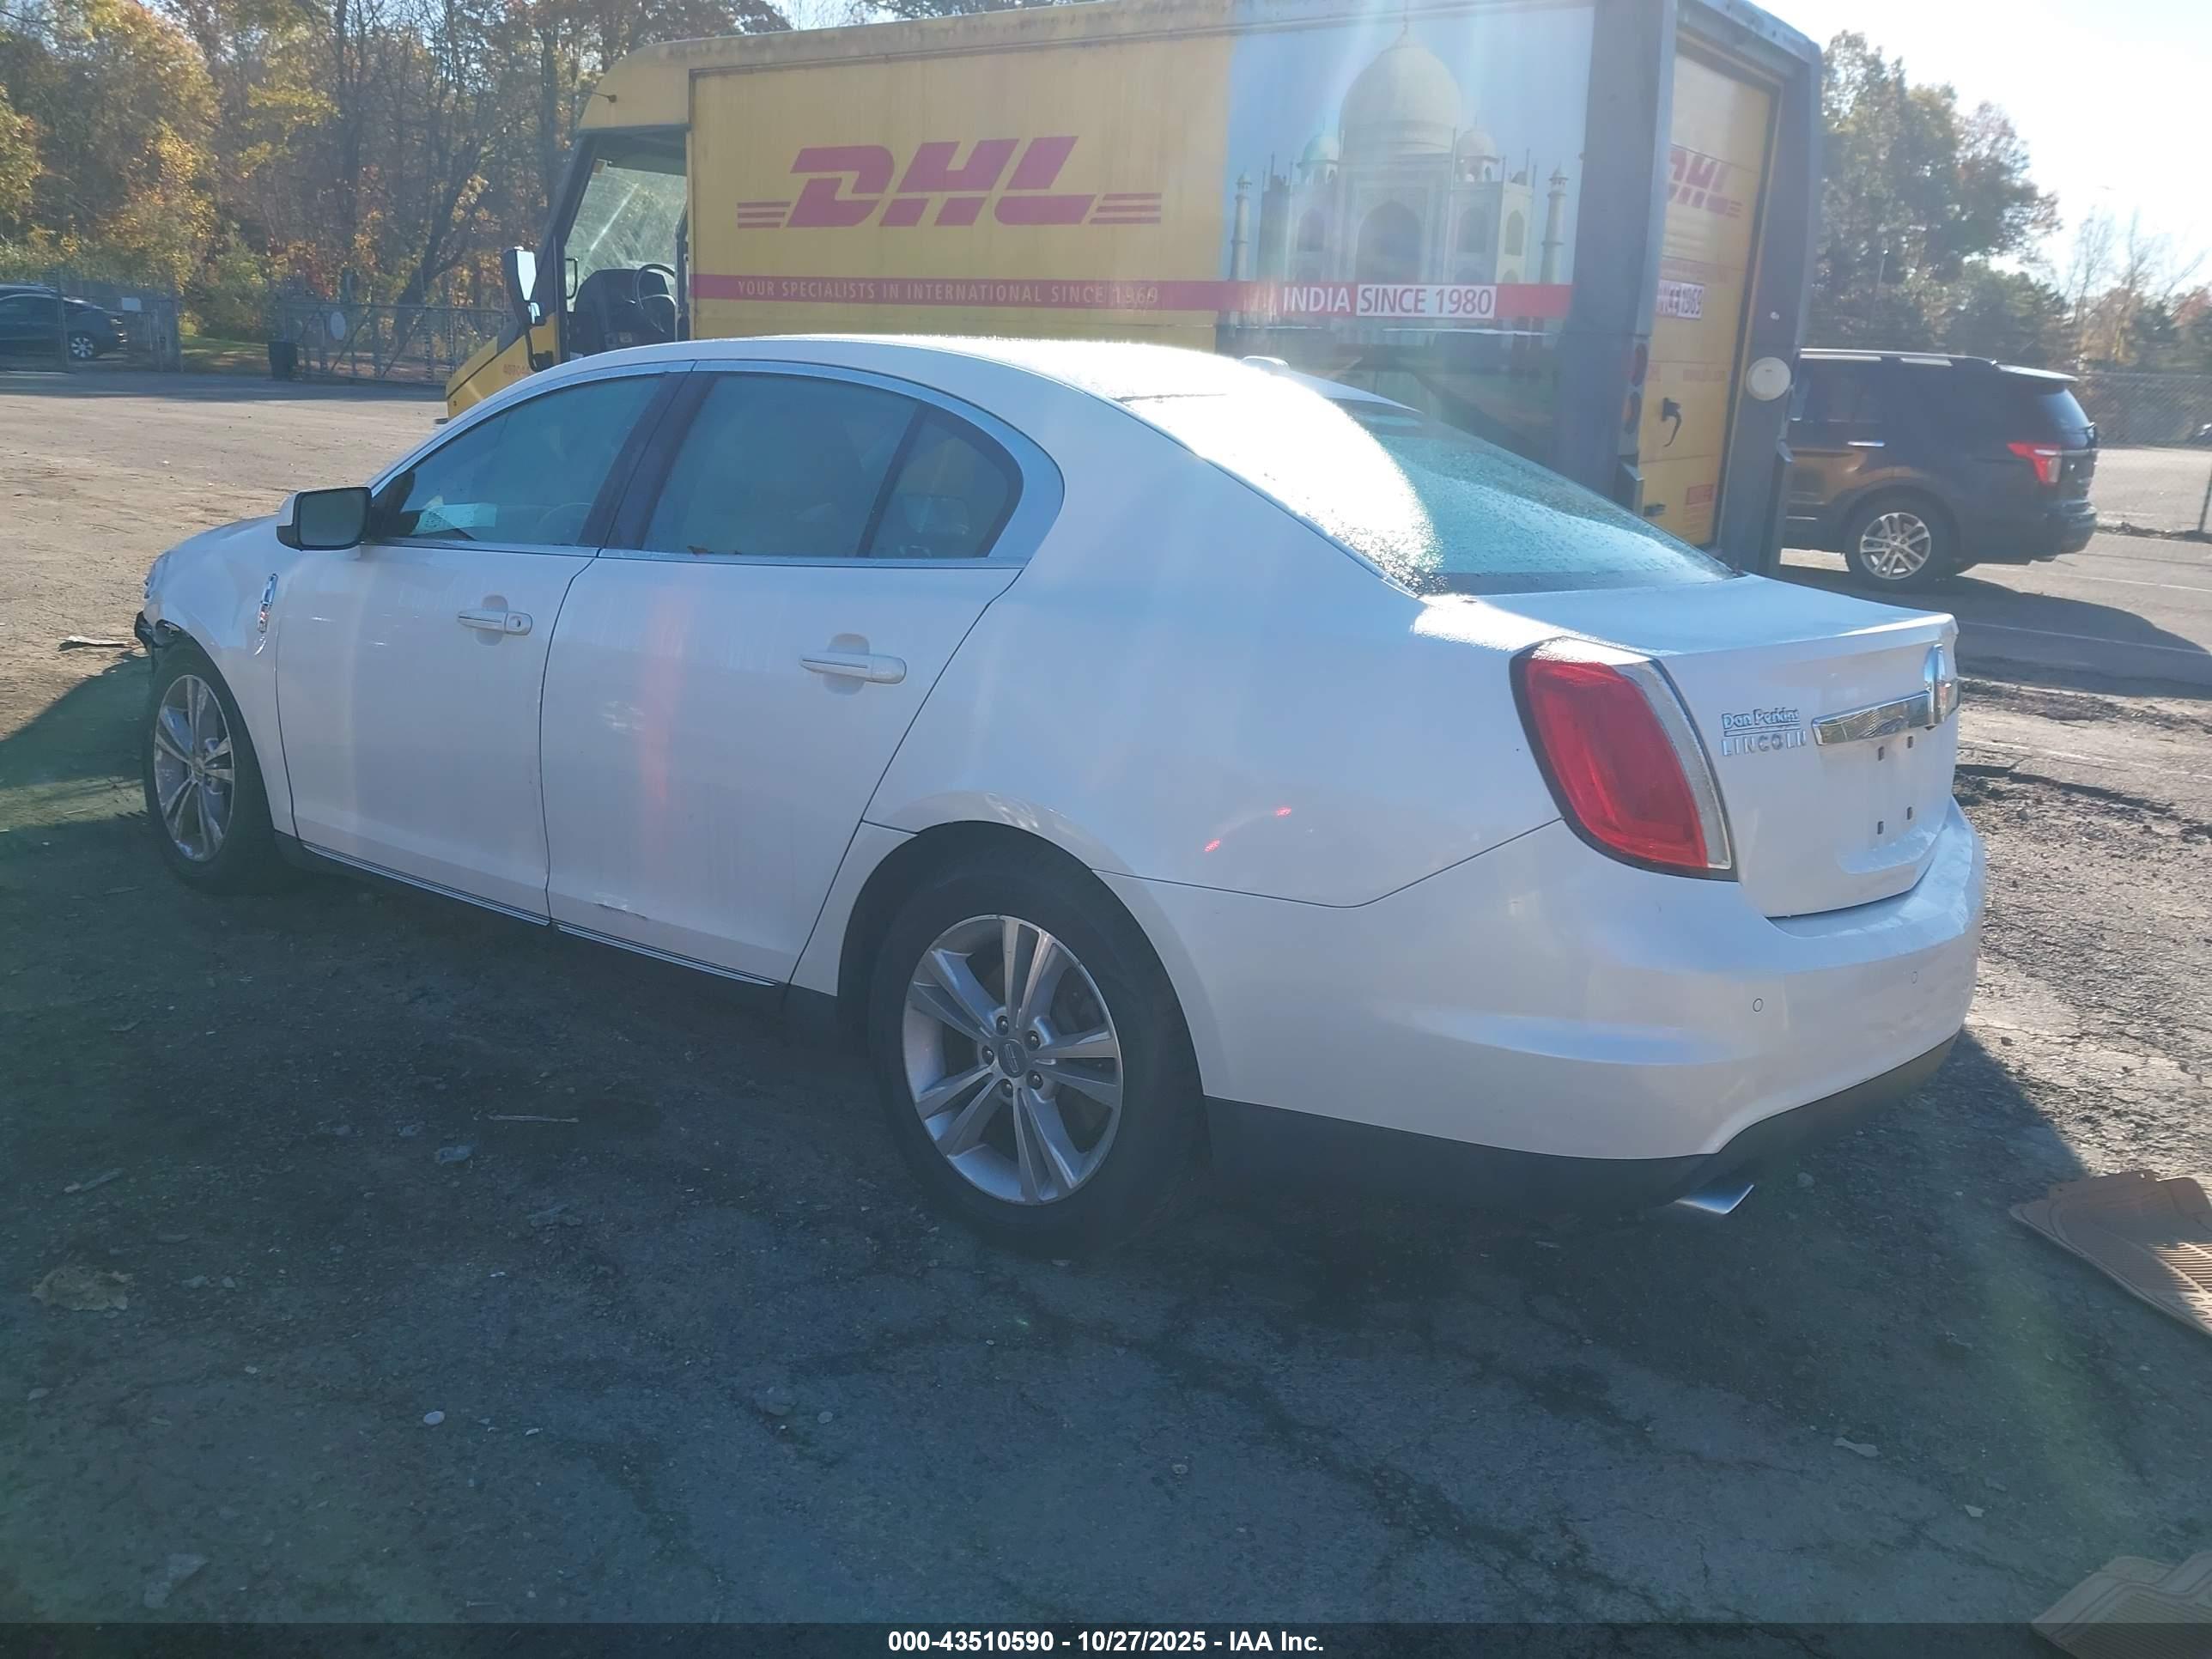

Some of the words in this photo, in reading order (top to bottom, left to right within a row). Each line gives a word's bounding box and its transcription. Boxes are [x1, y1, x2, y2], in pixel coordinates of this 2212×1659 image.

[787, 136, 1097, 228] DHL
[738, 280, 775, 297] YOUR
[781, 281, 876, 300] SPECIALISTS
[883, 283, 900, 300] IN
[907, 284, 1042, 303] INTERNATIONAL
[1049, 285, 1105, 304] SINCE
[1284, 287, 1352, 313] INDIA
[1360, 288, 1427, 314] SINCE
[1436, 289, 1492, 316] 1980
[1721, 730, 1807, 757] LINCOLN
